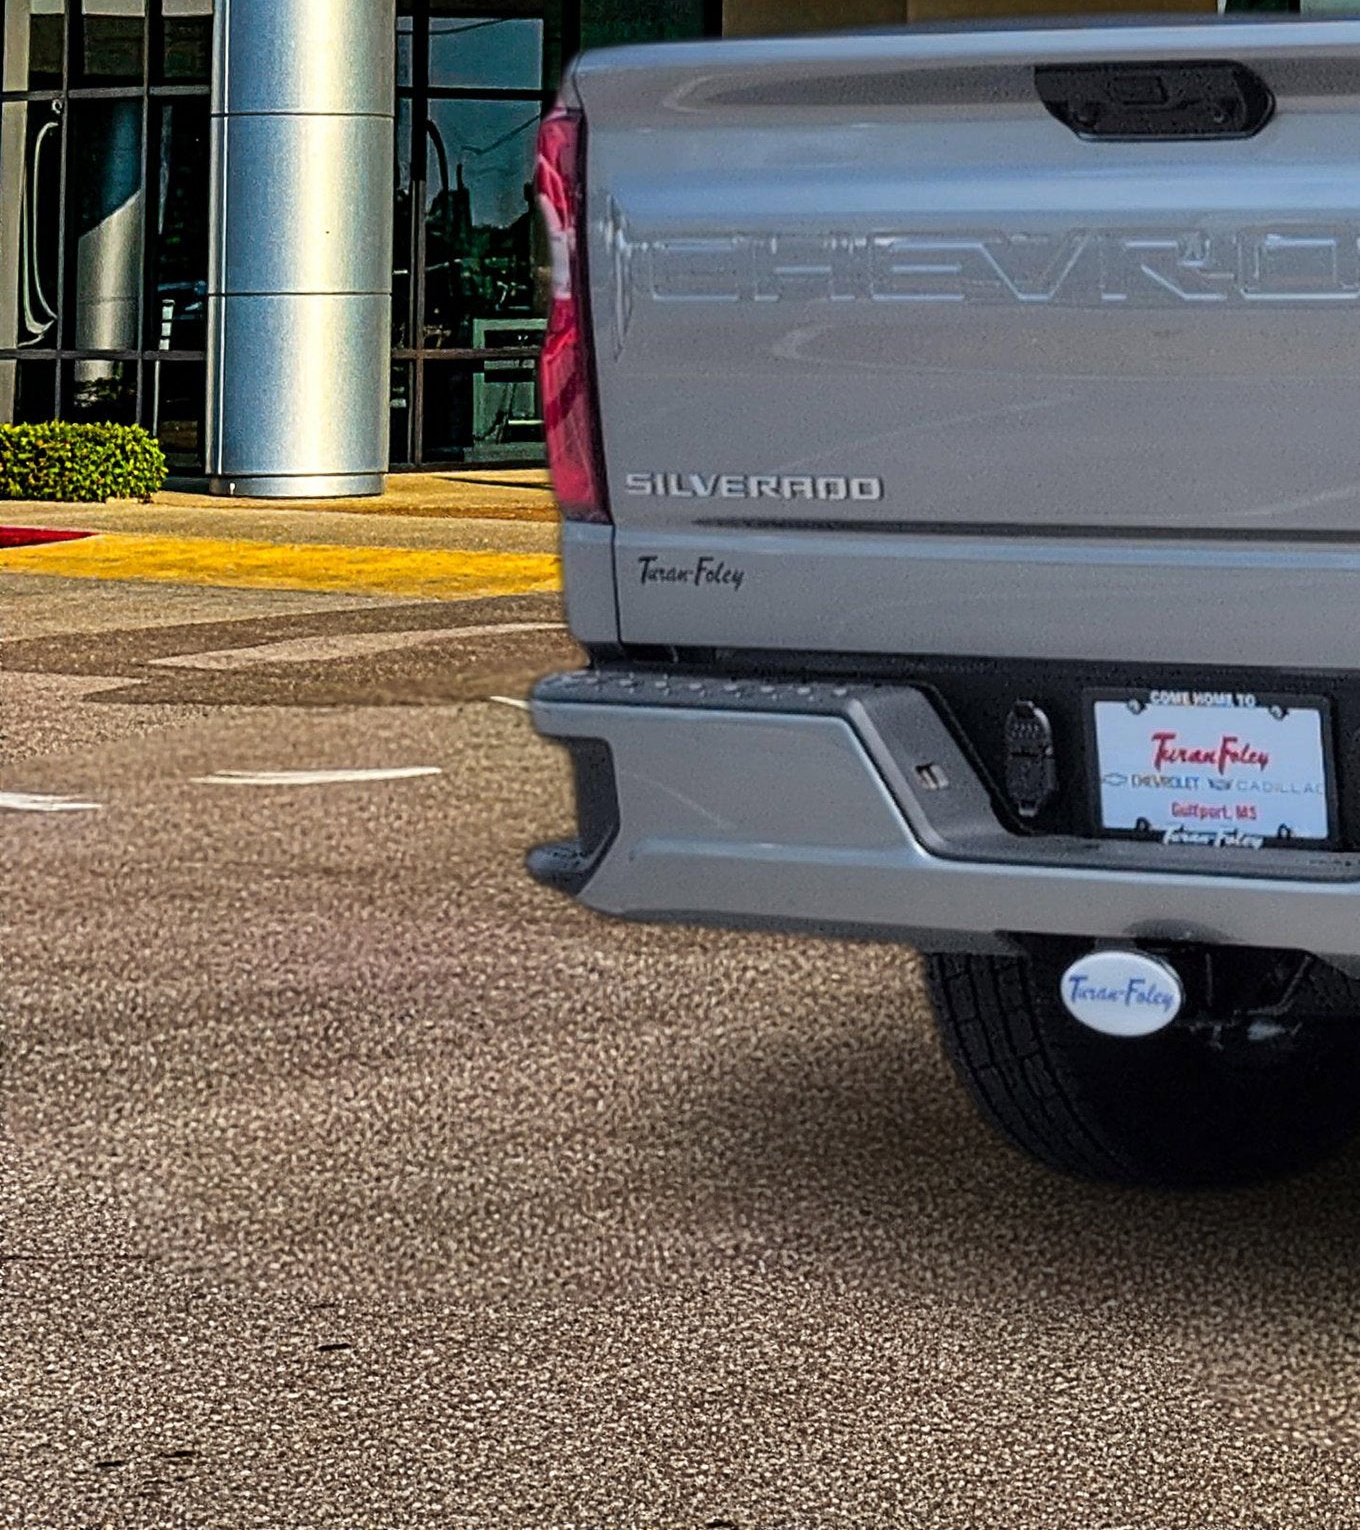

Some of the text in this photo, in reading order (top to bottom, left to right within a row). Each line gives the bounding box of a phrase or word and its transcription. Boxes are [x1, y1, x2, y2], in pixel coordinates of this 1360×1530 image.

[625, 472, 884, 501] SILVERADO
[1150, 689, 1257, 708] COME HOME TO
[1131, 773, 1199, 791] CHEVROLET
[1236, 805, 1258, 820] MS
